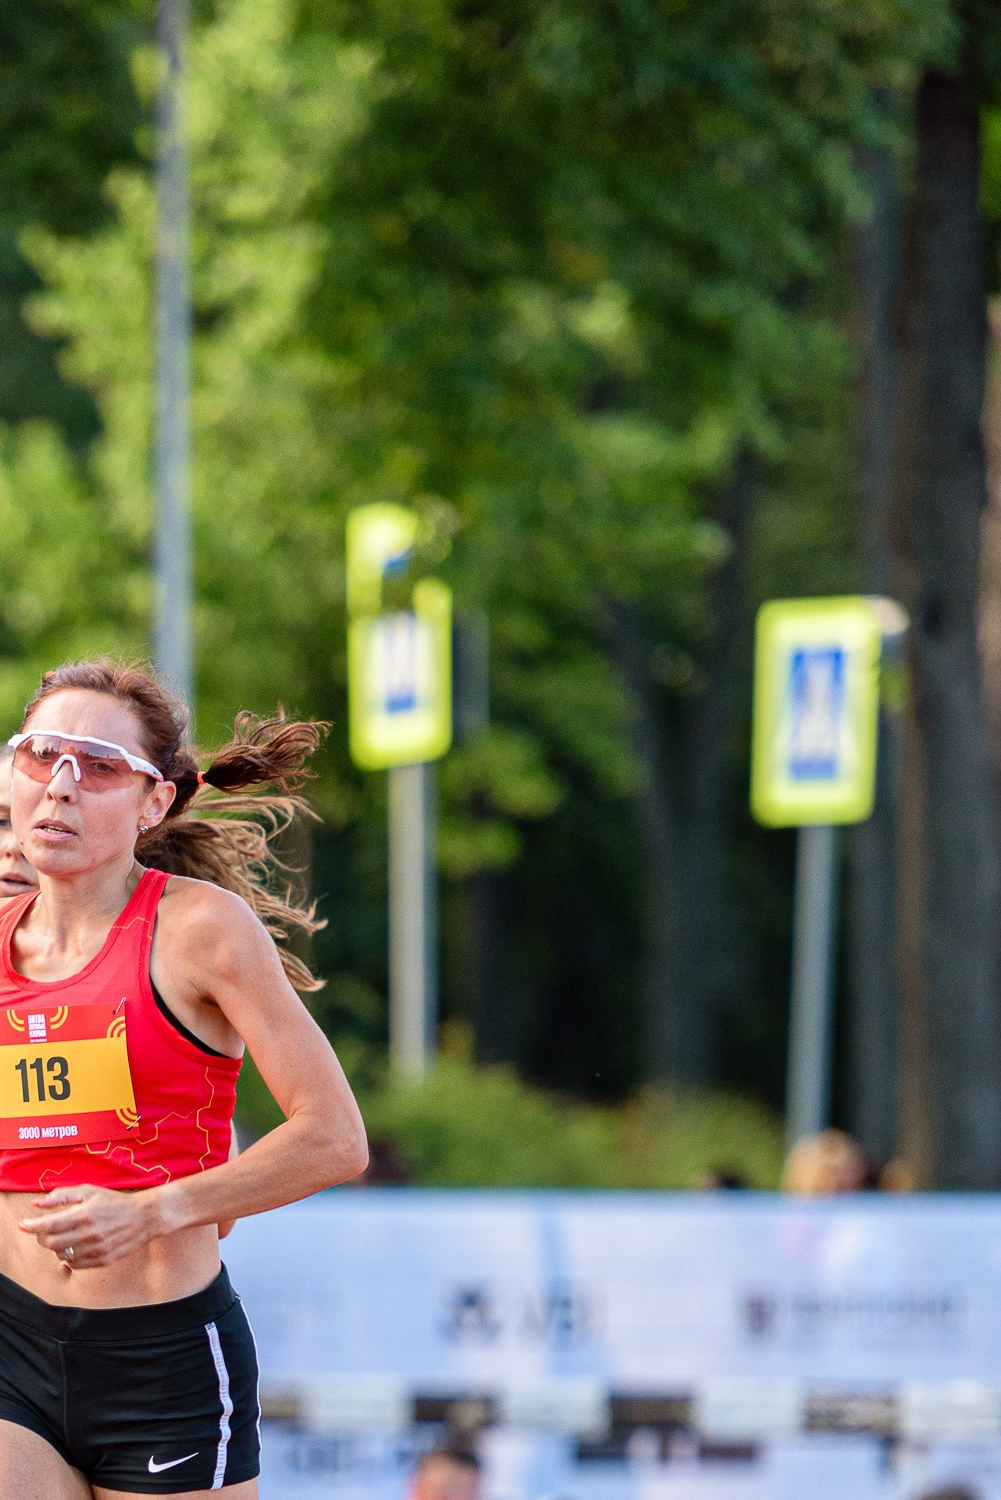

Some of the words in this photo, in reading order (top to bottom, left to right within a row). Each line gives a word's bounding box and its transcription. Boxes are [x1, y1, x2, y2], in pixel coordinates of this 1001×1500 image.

[15, 1056, 71, 1102] 113
[18, 1126, 40, 1139] 3000
[41, 1125, 78, 1139] метров
